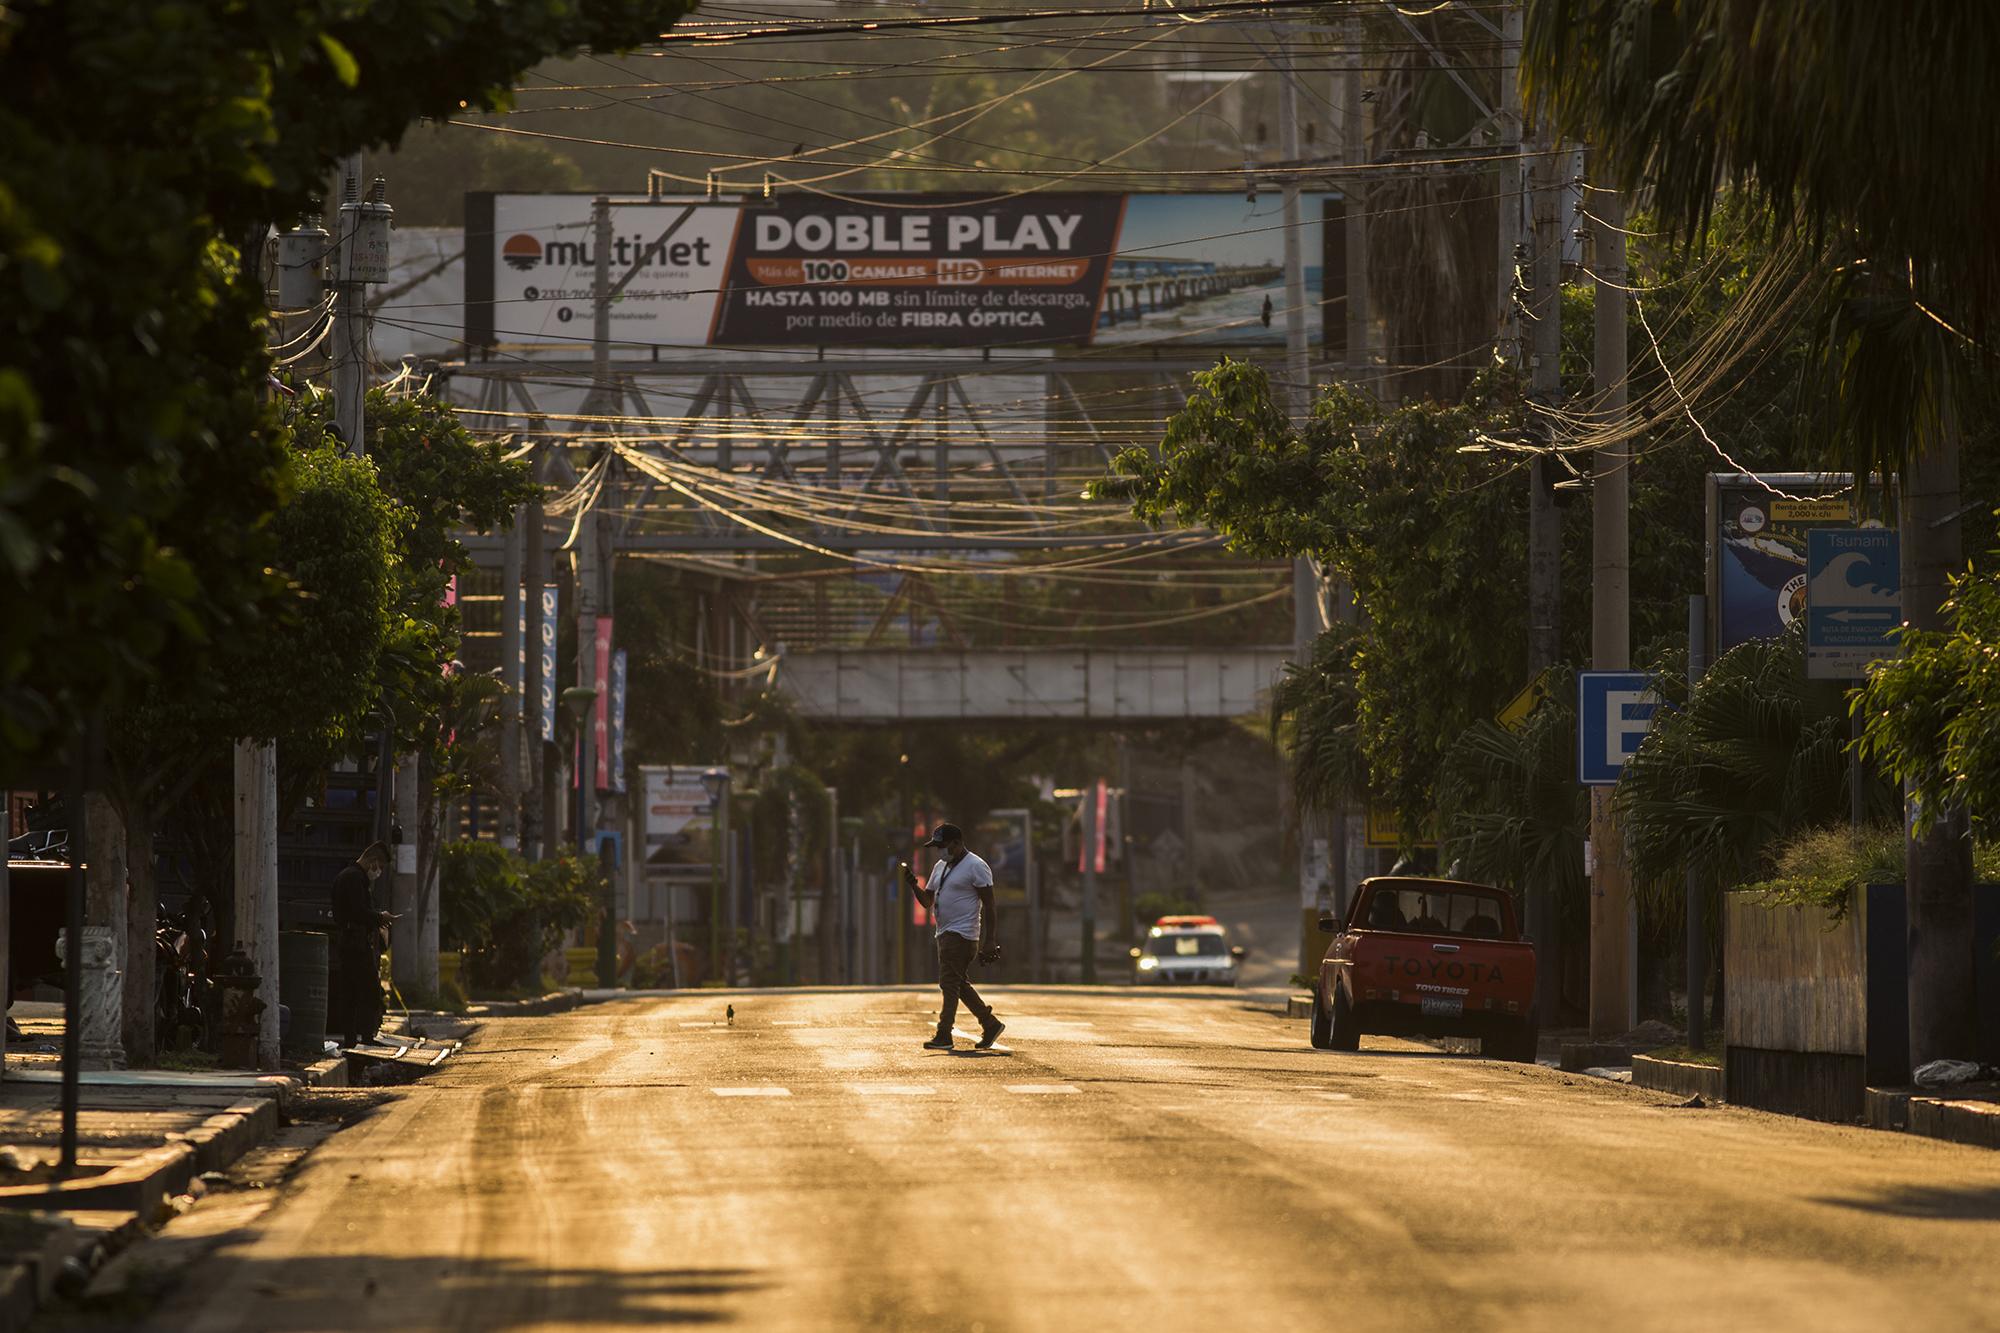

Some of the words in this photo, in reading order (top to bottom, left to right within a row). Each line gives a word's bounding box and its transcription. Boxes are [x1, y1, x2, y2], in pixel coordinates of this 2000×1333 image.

[756, 214, 931, 251] DOBLE
[947, 214, 1082, 251] PLAY
[545, 234, 711, 267] mutinet
[758, 263, 782, 276] Más
[784, 264, 798, 276] de
[804, 260, 848, 283] 100
[852, 266, 925, 279] CANALES
[938, 259, 984, 285] HD
[999, 265, 1078, 278] INTERNET
[746, 292, 818, 307] HASTA
[819, 292, 863, 307] 100
[867, 292, 890, 307] MB
[894, 290, 921, 307] sin
[925, 290, 977, 307] límite
[982, 290, 1003, 307] de
[1007, 290, 1091, 309] descarga,
[786, 314, 815, 330] por
[819, 312, 872, 327] medio
[876, 312, 897, 327] de
[902, 312, 962, 327] FIBRA
[968, 309, 1044, 327] ÓPTICA
[1775, 503, 1797, 511] Renta
[1798, 503, 1808, 511] de
[1827, 533, 1889, 548] Tsunami
[1784, 576, 1806, 594] THE
[1606, 690, 1657, 766] E
[1384, 955, 1505, 984] TOYOTA
